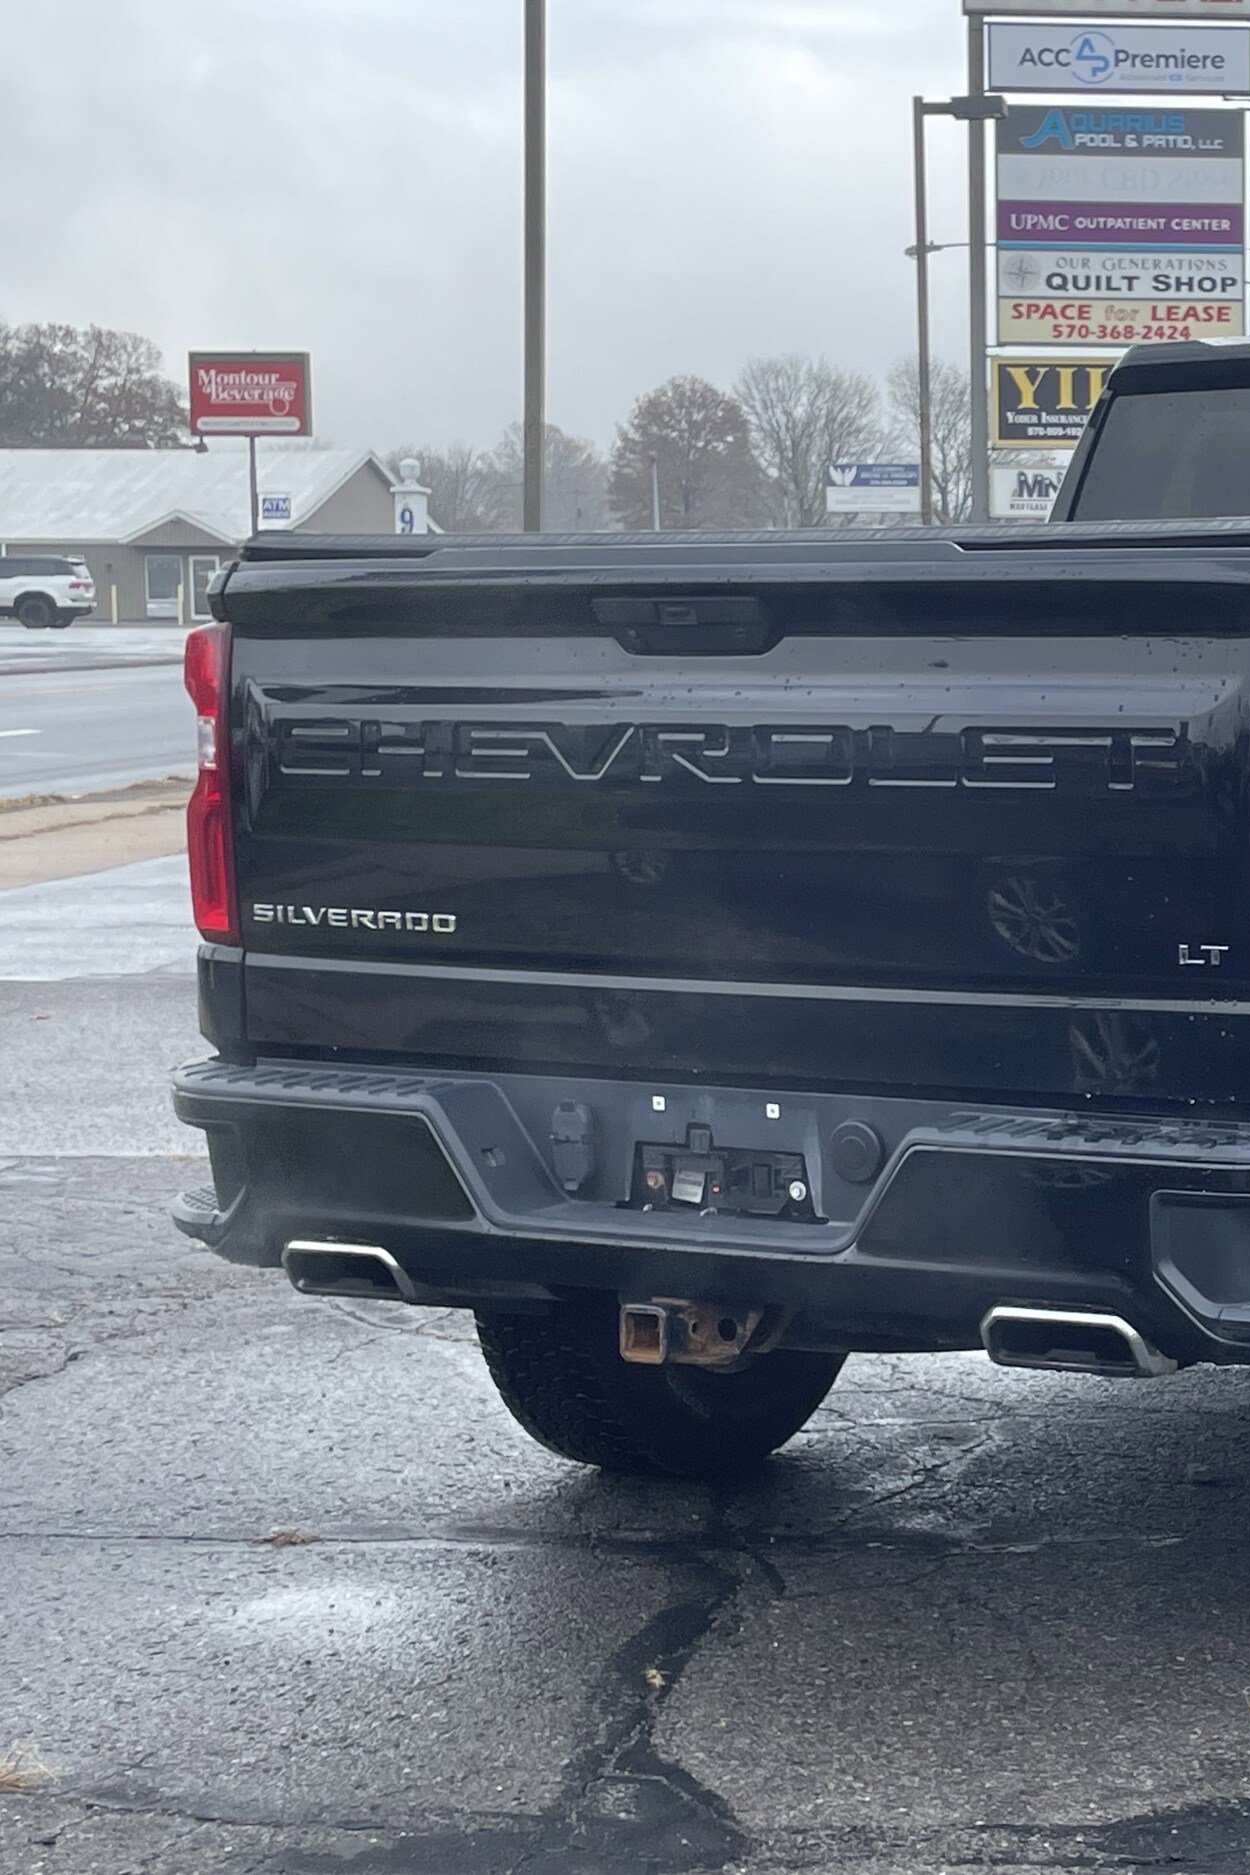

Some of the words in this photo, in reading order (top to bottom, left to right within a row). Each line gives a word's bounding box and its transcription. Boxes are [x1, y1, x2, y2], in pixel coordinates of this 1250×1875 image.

[1018, 48, 1071, 67] ACC
[1114, 48, 1225, 69] Premiere
[1019, 109, 1185, 149] AQUARIUS
[1074, 133, 1121, 147] POOL
[1125, 134, 1138, 147] &
[1143, 135, 1195, 150] PATIO,
[1198, 139, 1223, 149] LLC
[1010, 213, 1069, 231] UPMC
[1074, 216, 1166, 230] OUTPATIENT
[1170, 218, 1231, 231] CENTER
[1056, 256, 1092, 270] OUR
[1101, 257, 1228, 272] GENERATIONS
[1046, 272, 1140, 292] QUILT
[1152, 274, 1238, 293] SHOP
[1011, 303, 1092, 321] SPACE
[1104, 304, 1140, 321] for
[1151, 305, 1231, 322] LEASE
[1052, 324, 1191, 340] 570-368-2424
[197, 368, 280, 386] Montour
[209, 383, 297, 415] Beverage
[1041, 412, 1089, 424] INSURANC
[263, 498, 290, 510] ATM
[276, 719, 1179, 790] CHEVROLET
[253, 903, 457, 933] SILVERADO
[1179, 944, 1229, 966] LT
